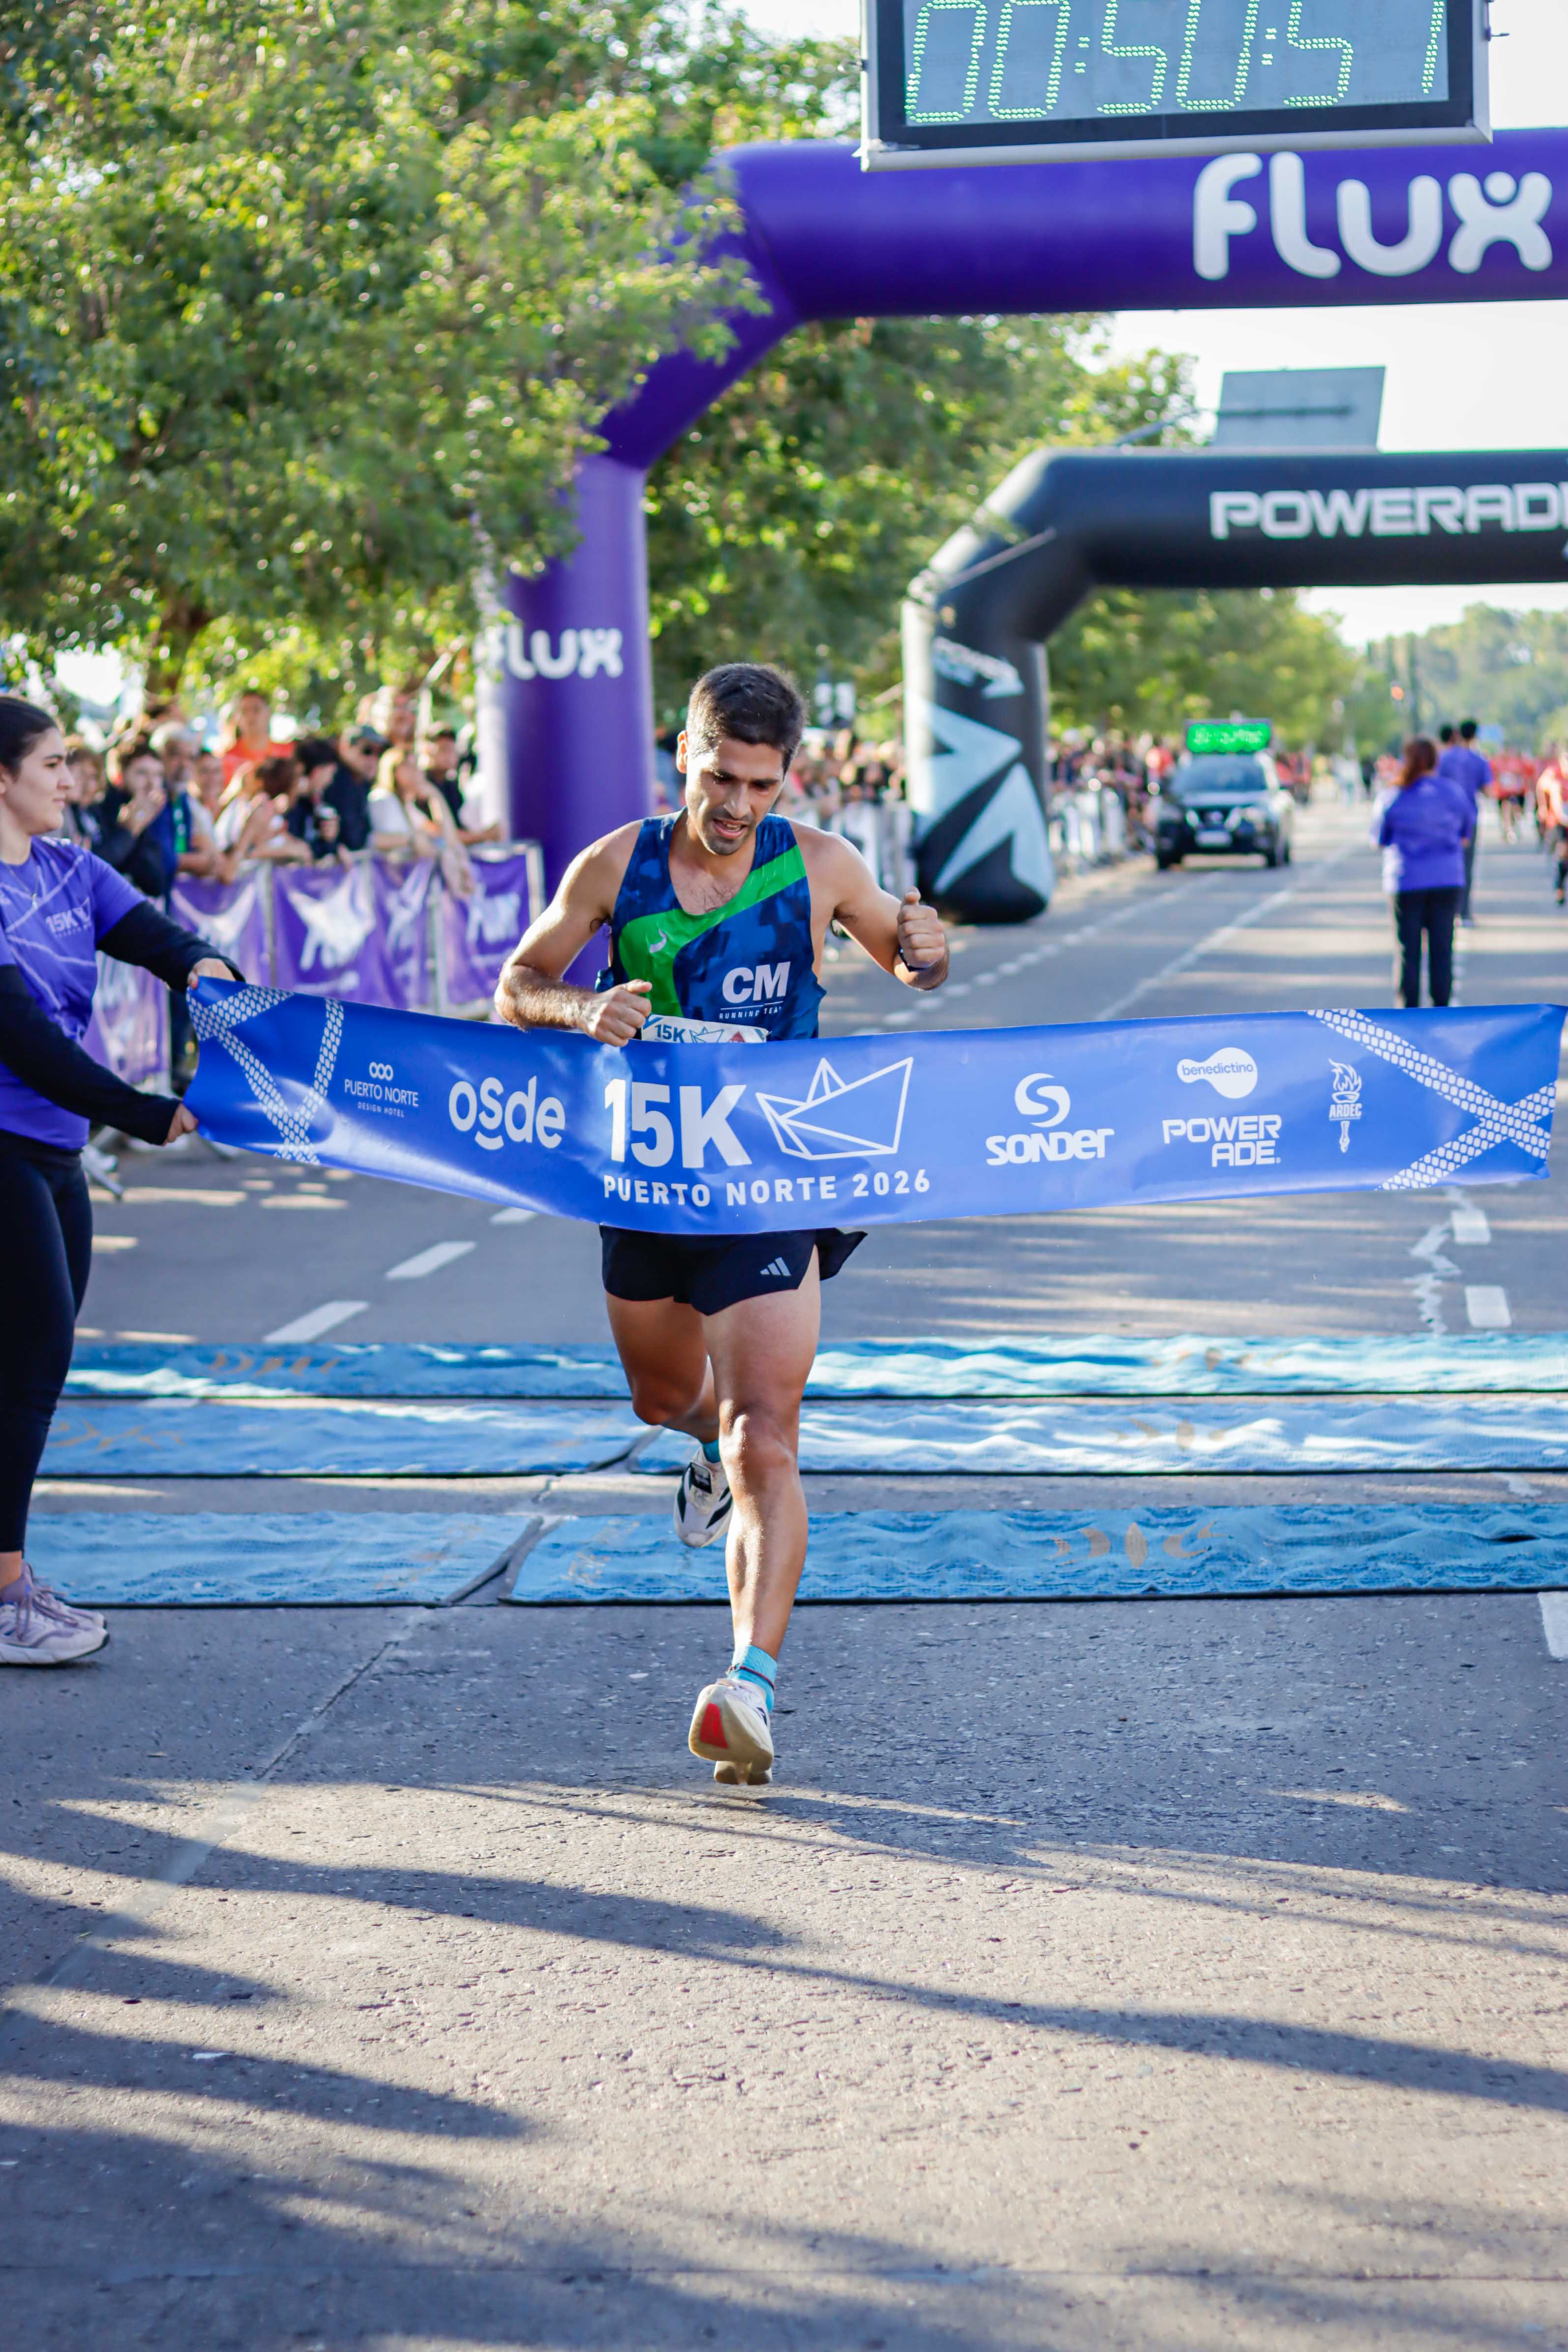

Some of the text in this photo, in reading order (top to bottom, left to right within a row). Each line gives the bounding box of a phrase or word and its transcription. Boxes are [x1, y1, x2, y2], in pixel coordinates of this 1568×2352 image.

[1210, 481, 1568, 540] POWERAD
[46, 910, 79, 934] 15K
[722, 961, 791, 1003] CM
[719, 1010, 760, 1019] RUNNING
[654, 1024, 686, 1042] 15K
[1182, 1062, 1254, 1076] benedictino
[344, 1078, 419, 1107] PUERTO NORTE
[357, 1102, 405, 1117] DESIGN HOTEL
[1329, 1103, 1362, 1118] ARDEC
[604, 1079, 752, 1168] 15K
[1162, 1114, 1282, 1144] POWER
[603, 1169, 930, 1207] PUERTO NORTE 2026
